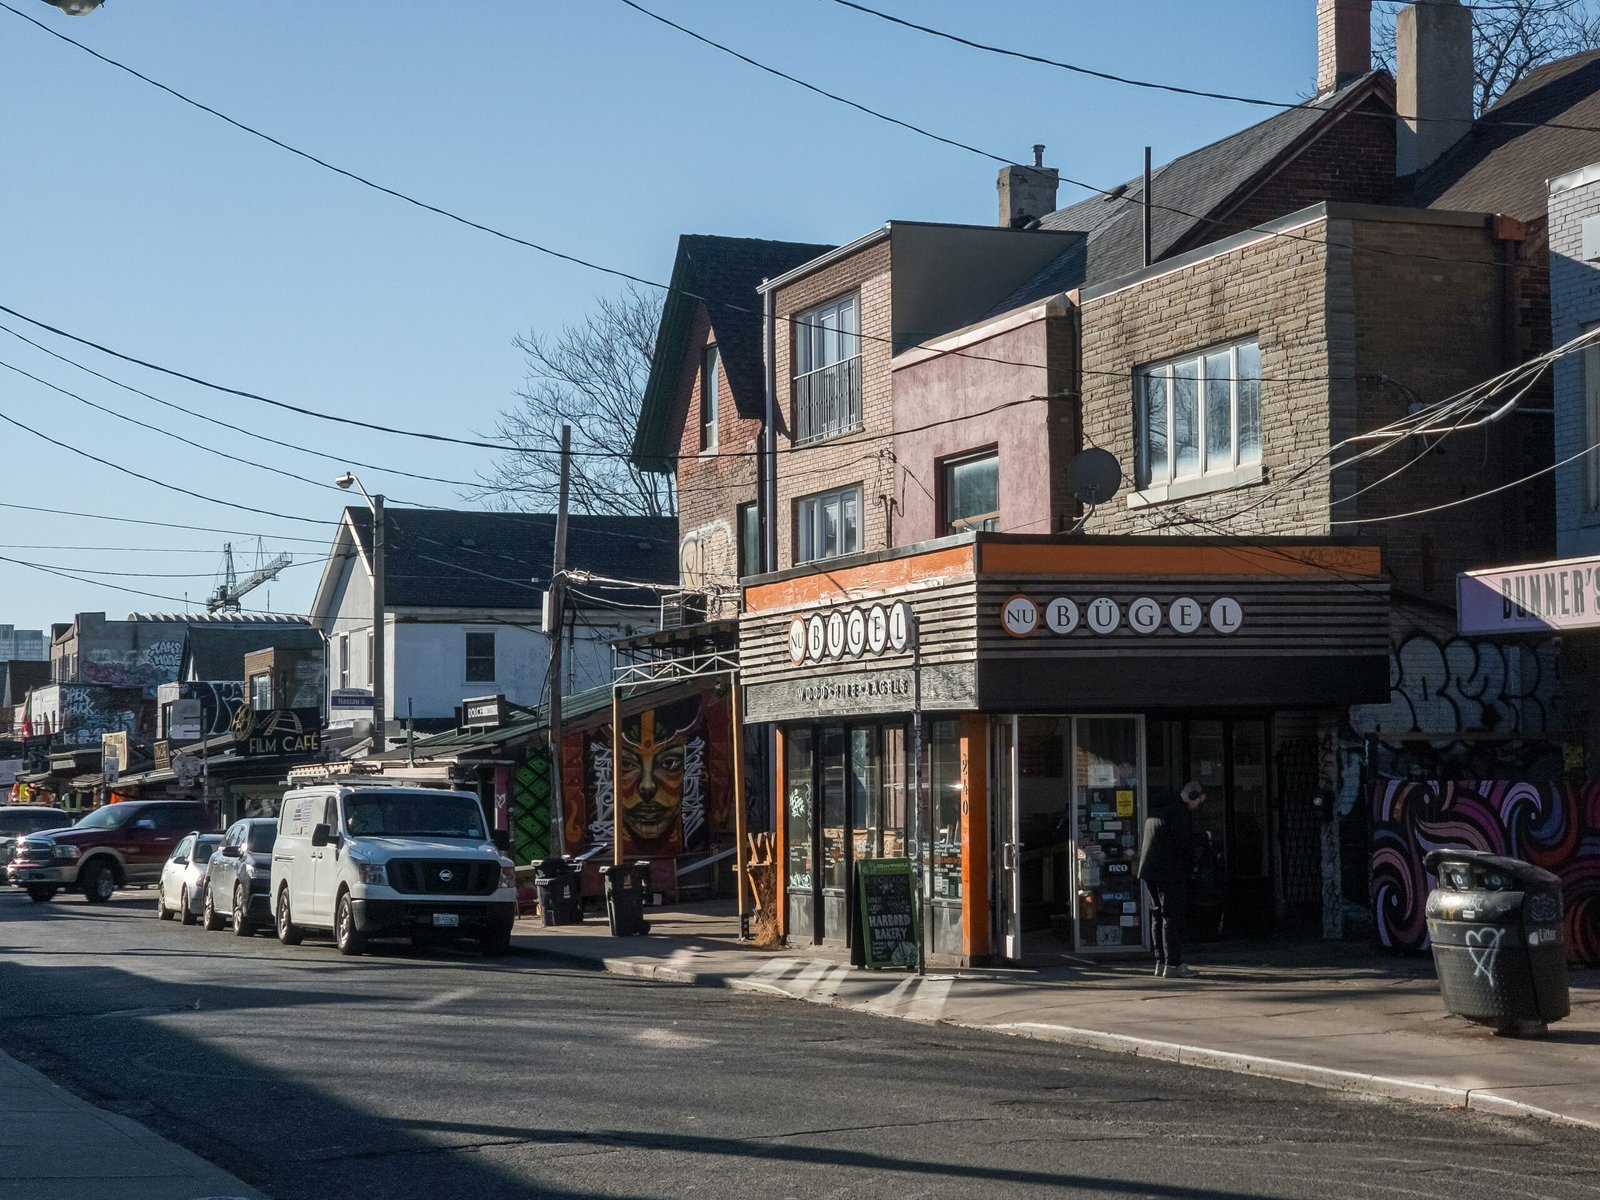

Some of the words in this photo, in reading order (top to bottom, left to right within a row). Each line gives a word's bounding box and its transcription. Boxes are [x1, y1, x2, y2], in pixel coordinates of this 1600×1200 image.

[1006, 609, 1034, 625] NU
[1056, 599, 1235, 627] BÜGEL
[791, 632, 804, 649] NU
[813, 612, 904, 651] BÜGEL
[250, 739, 276, 753] FILM
[283, 733, 318, 751] CAFÉ
[1109, 864, 1128, 872] neo
[869, 914, 911, 928] HARBORD
[875, 927, 907, 940] BAKERY
